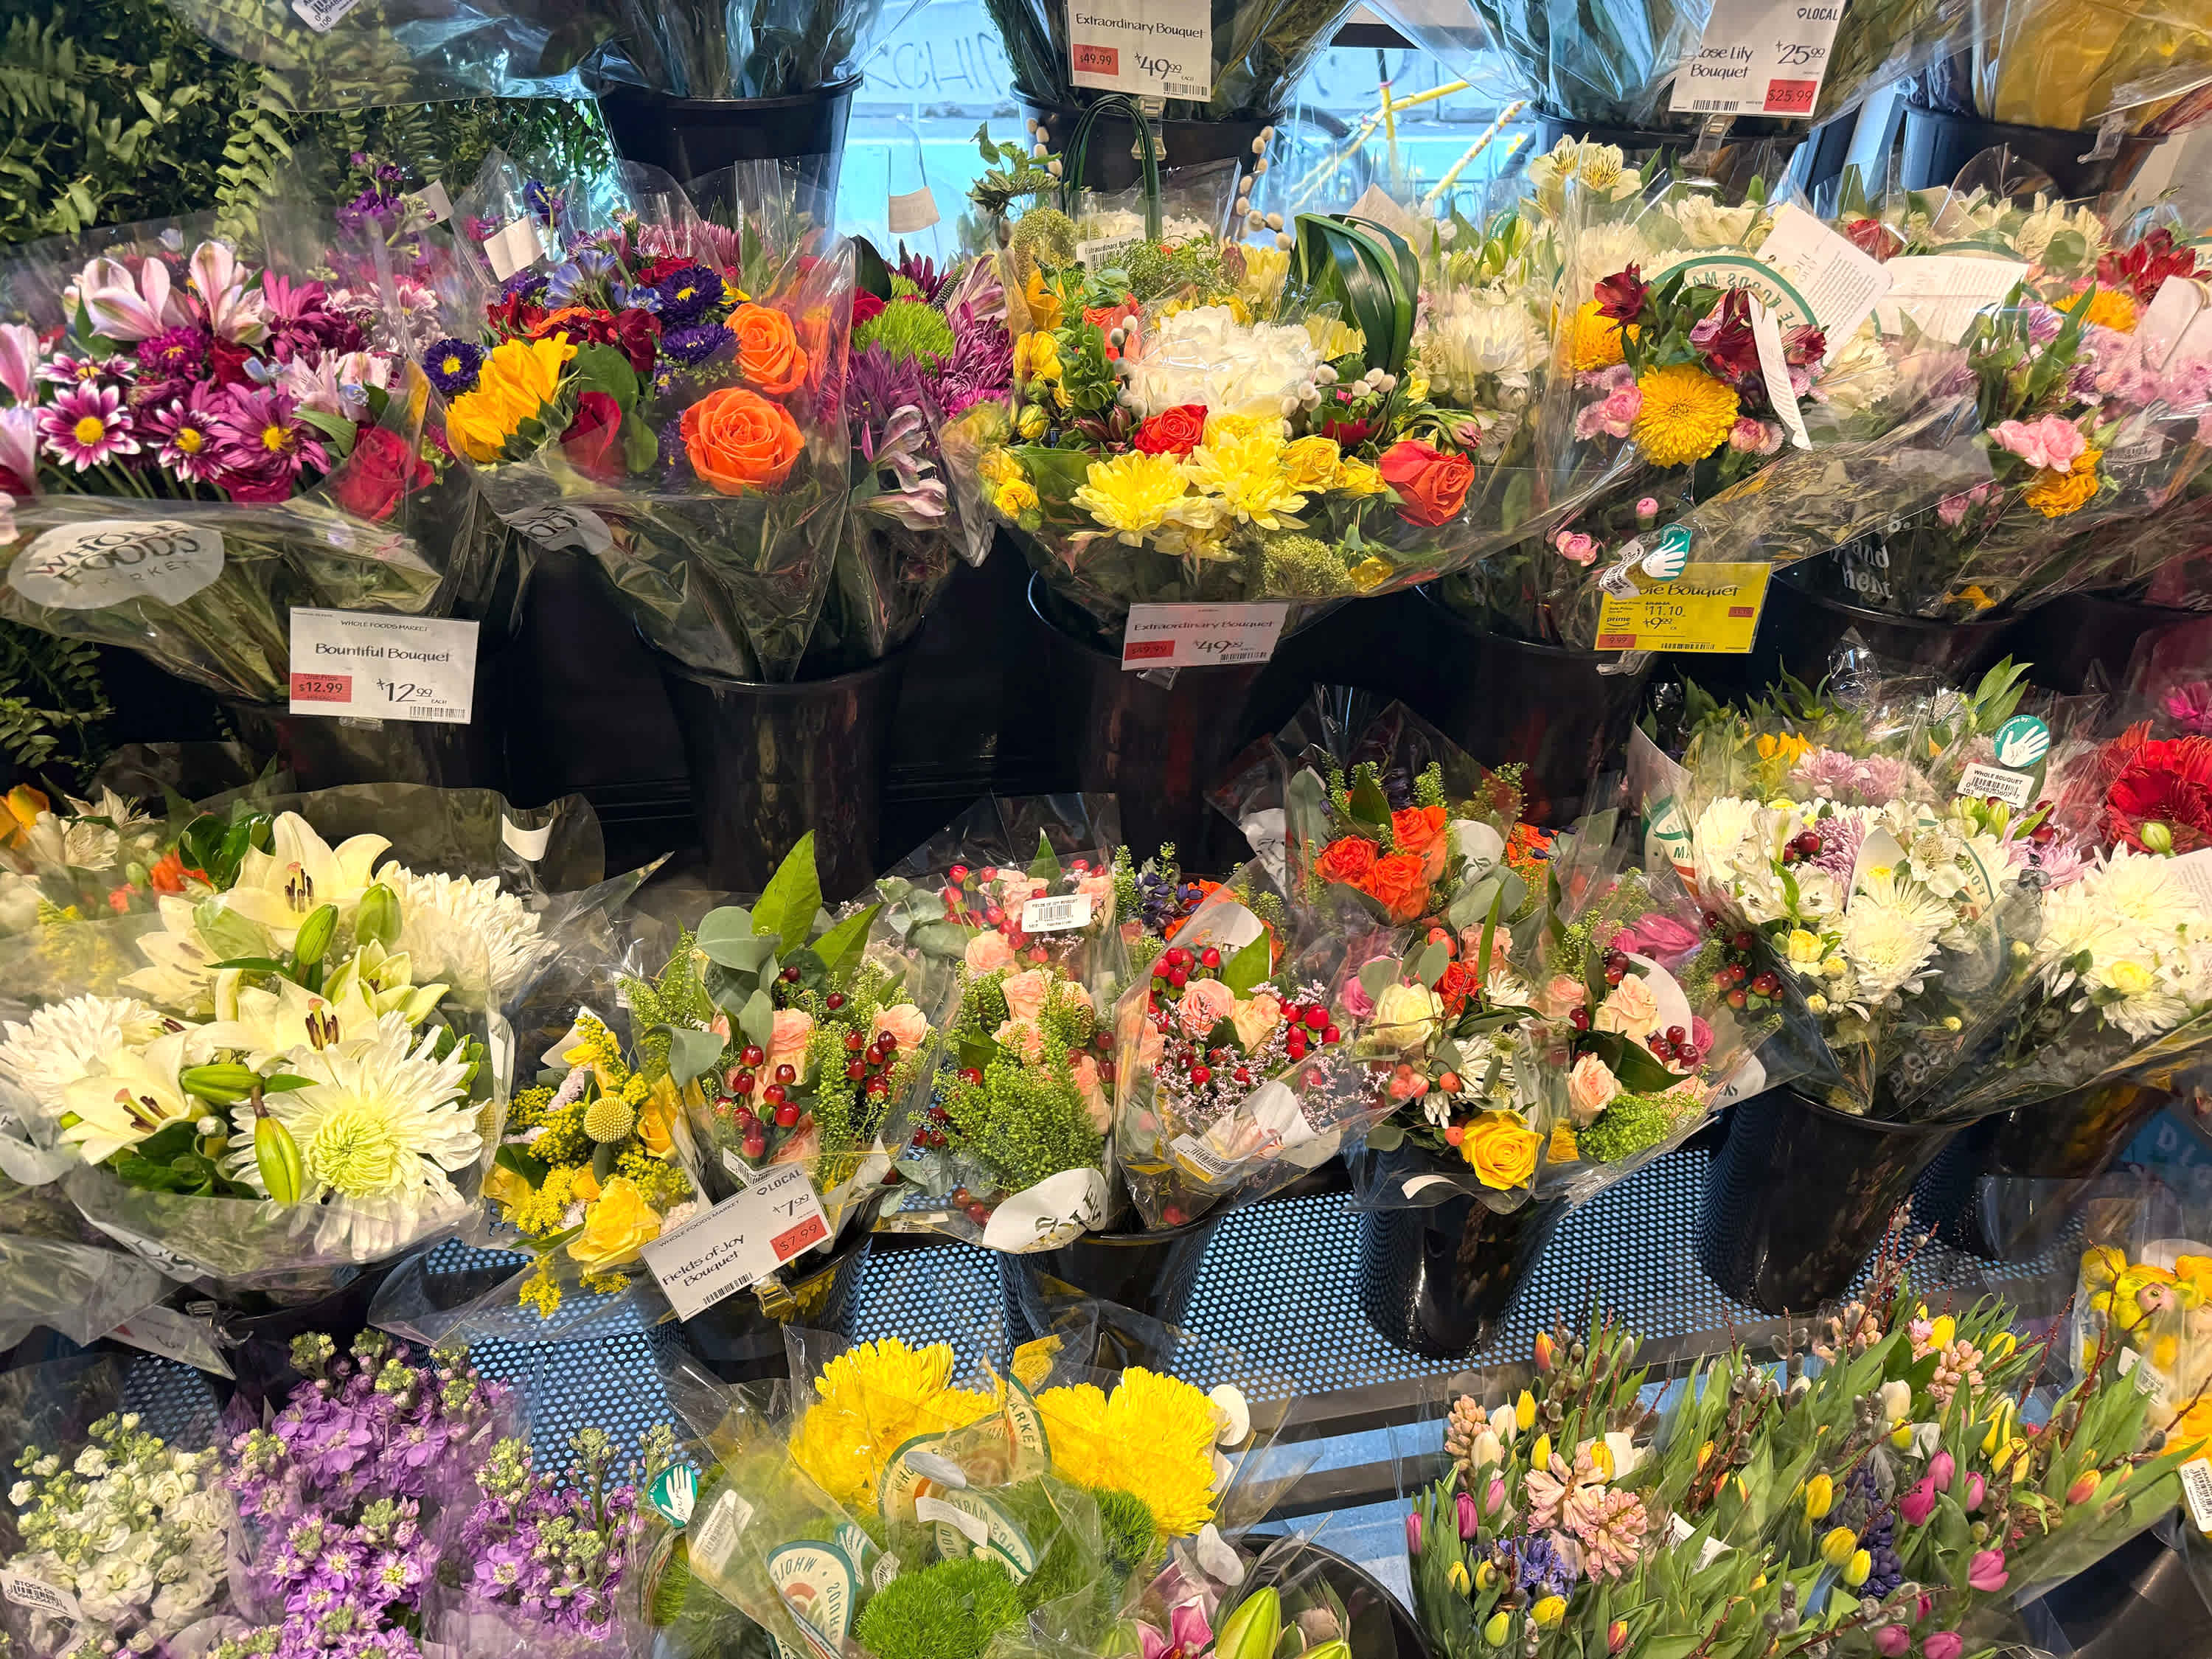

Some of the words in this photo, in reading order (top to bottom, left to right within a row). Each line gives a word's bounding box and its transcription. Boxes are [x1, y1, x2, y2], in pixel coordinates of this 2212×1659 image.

[1806, 7, 1838, 21] LOCAL
[1076, 13, 1154, 35] Extraordinary
[1155, 22, 1203, 39] Bouquet
[1079, 53, 1113, 66] $49.99
[1730, 46, 1754, 63] Lily
[1690, 63, 1750, 80] Bouquet
[1768, 88, 1814, 102] $25.99
[23, 524, 179, 575] WHOLE
[53, 530, 201, 588] FOODS
[1667, 583, 1741, 598] Bouquet
[341, 619, 366, 627] WHOLE
[369, 622, 398, 630] FOODS
[399, 624, 430, 632] MARKET
[1133, 620, 1218, 632] Extraordinary
[1220, 620, 1274, 630] Bouquet
[314, 642, 384, 658] Bountiful
[387, 648, 450, 663] Bouquet
[299, 681, 344, 694] $12.99
[1974, 769, 1994, 779] WHOLE
[1994, 774, 2023, 785] BOUQUET
[768, 1169, 803, 1192] LOCAL
[658, 1231, 686, 1248] WHOLE
[686, 1218, 712, 1234] FOODS
[712, 1200, 740, 1219] MARKET
[661, 1258, 703, 1287] Fields
[705, 1245, 721, 1262] of
[719, 1234, 745, 1253] Joy
[684, 1250, 740, 1287] Bouquet
[14, 1579, 42, 1591] STOCK
